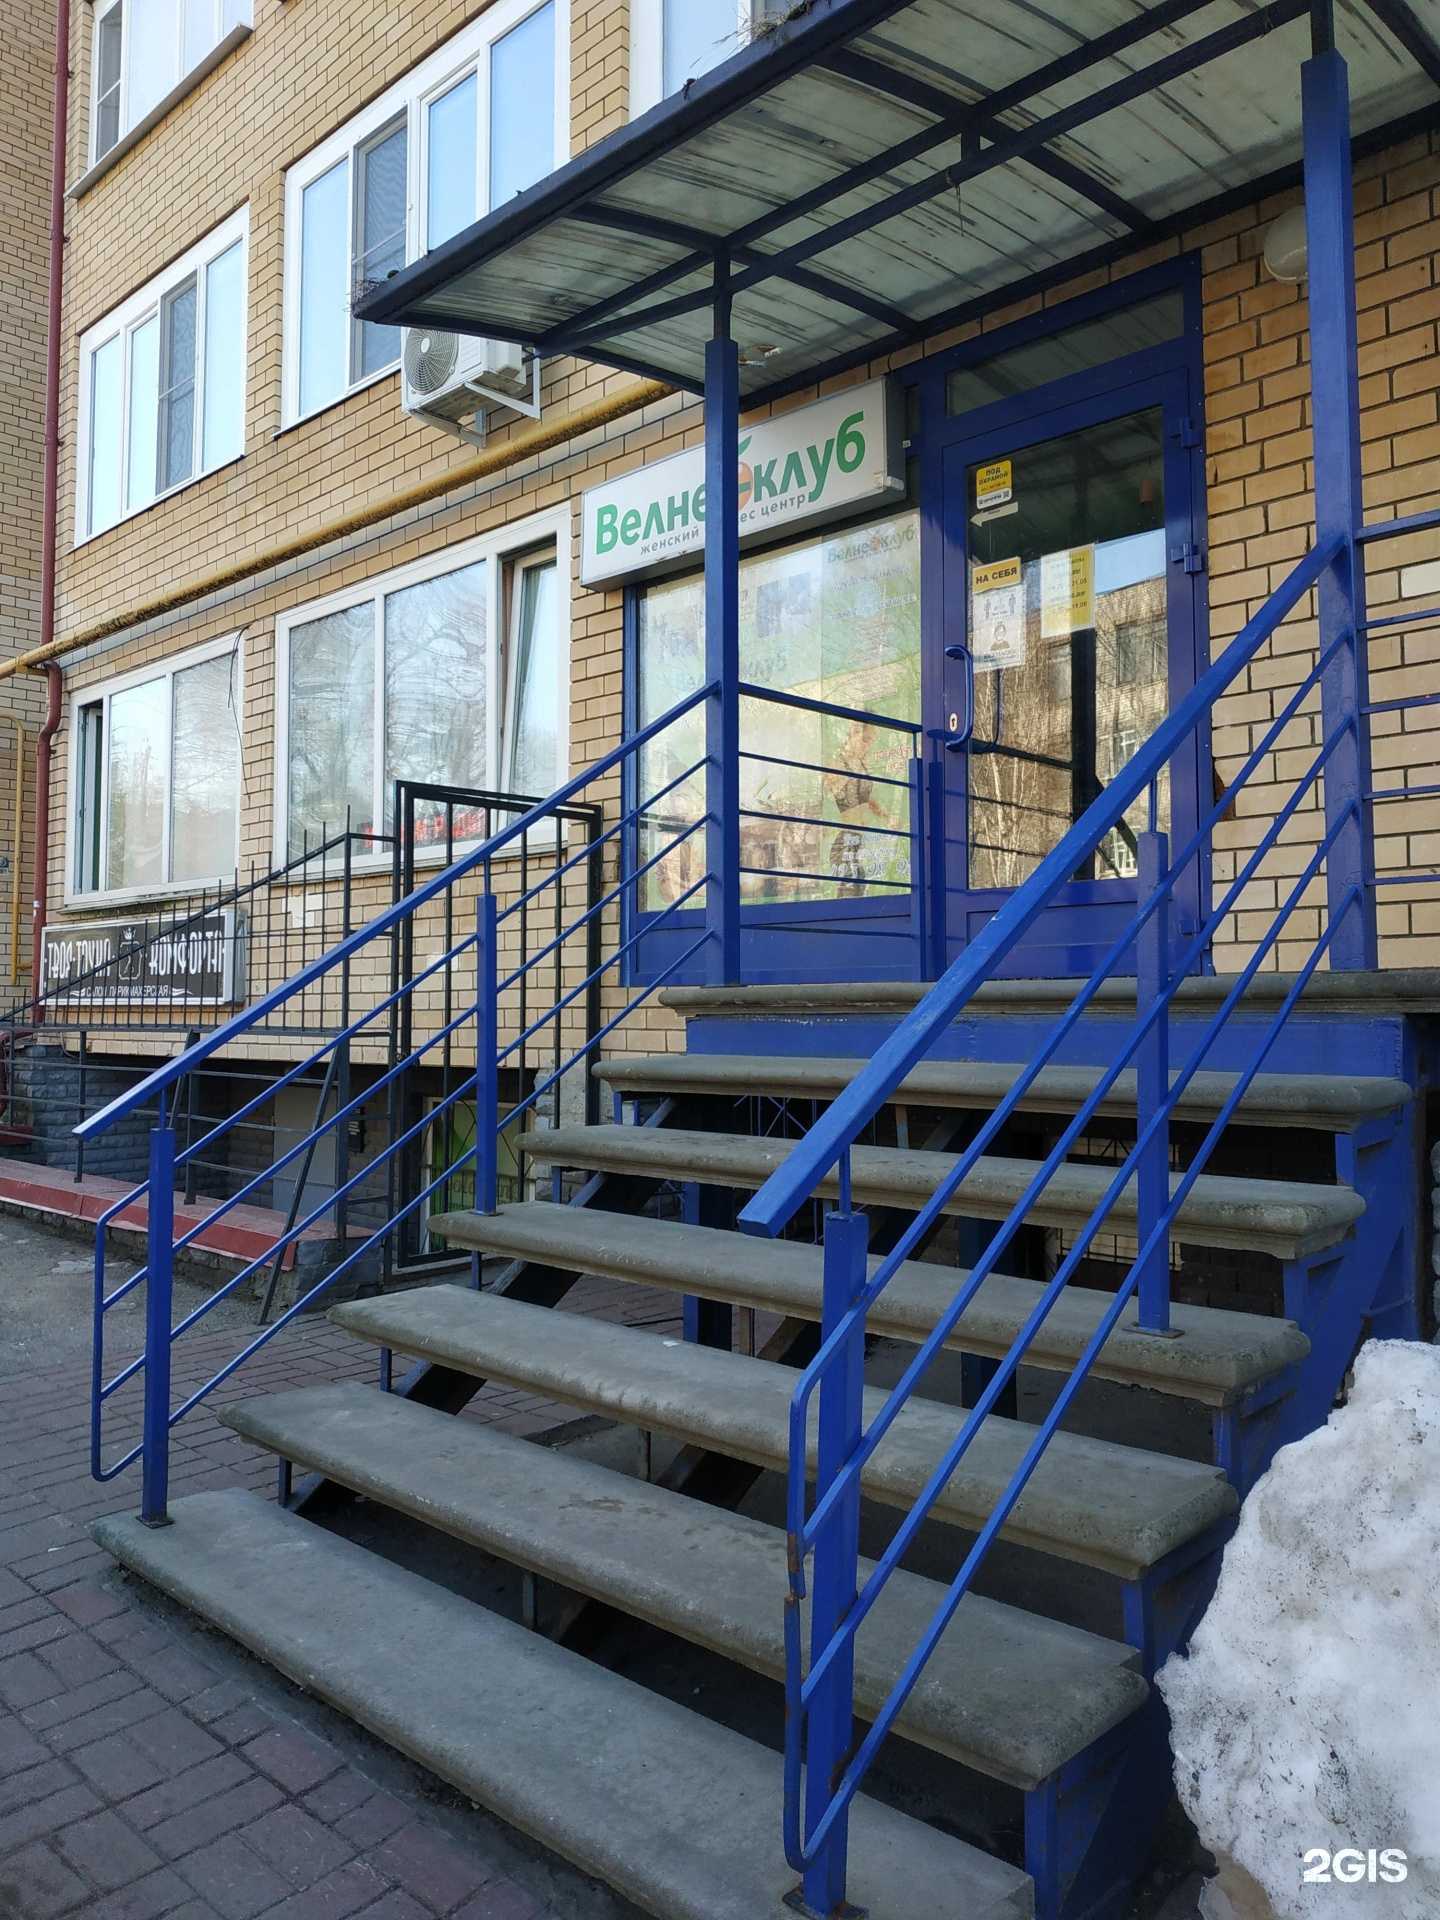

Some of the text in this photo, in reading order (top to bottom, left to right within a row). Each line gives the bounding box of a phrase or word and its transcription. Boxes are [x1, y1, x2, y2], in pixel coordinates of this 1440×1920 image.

[753, 408, 866, 504] клуб
[640, 527, 699, 555] женский
[760, 494, 805, 517] центр
[975, 566, 1018, 585] НА СЕБЯ
